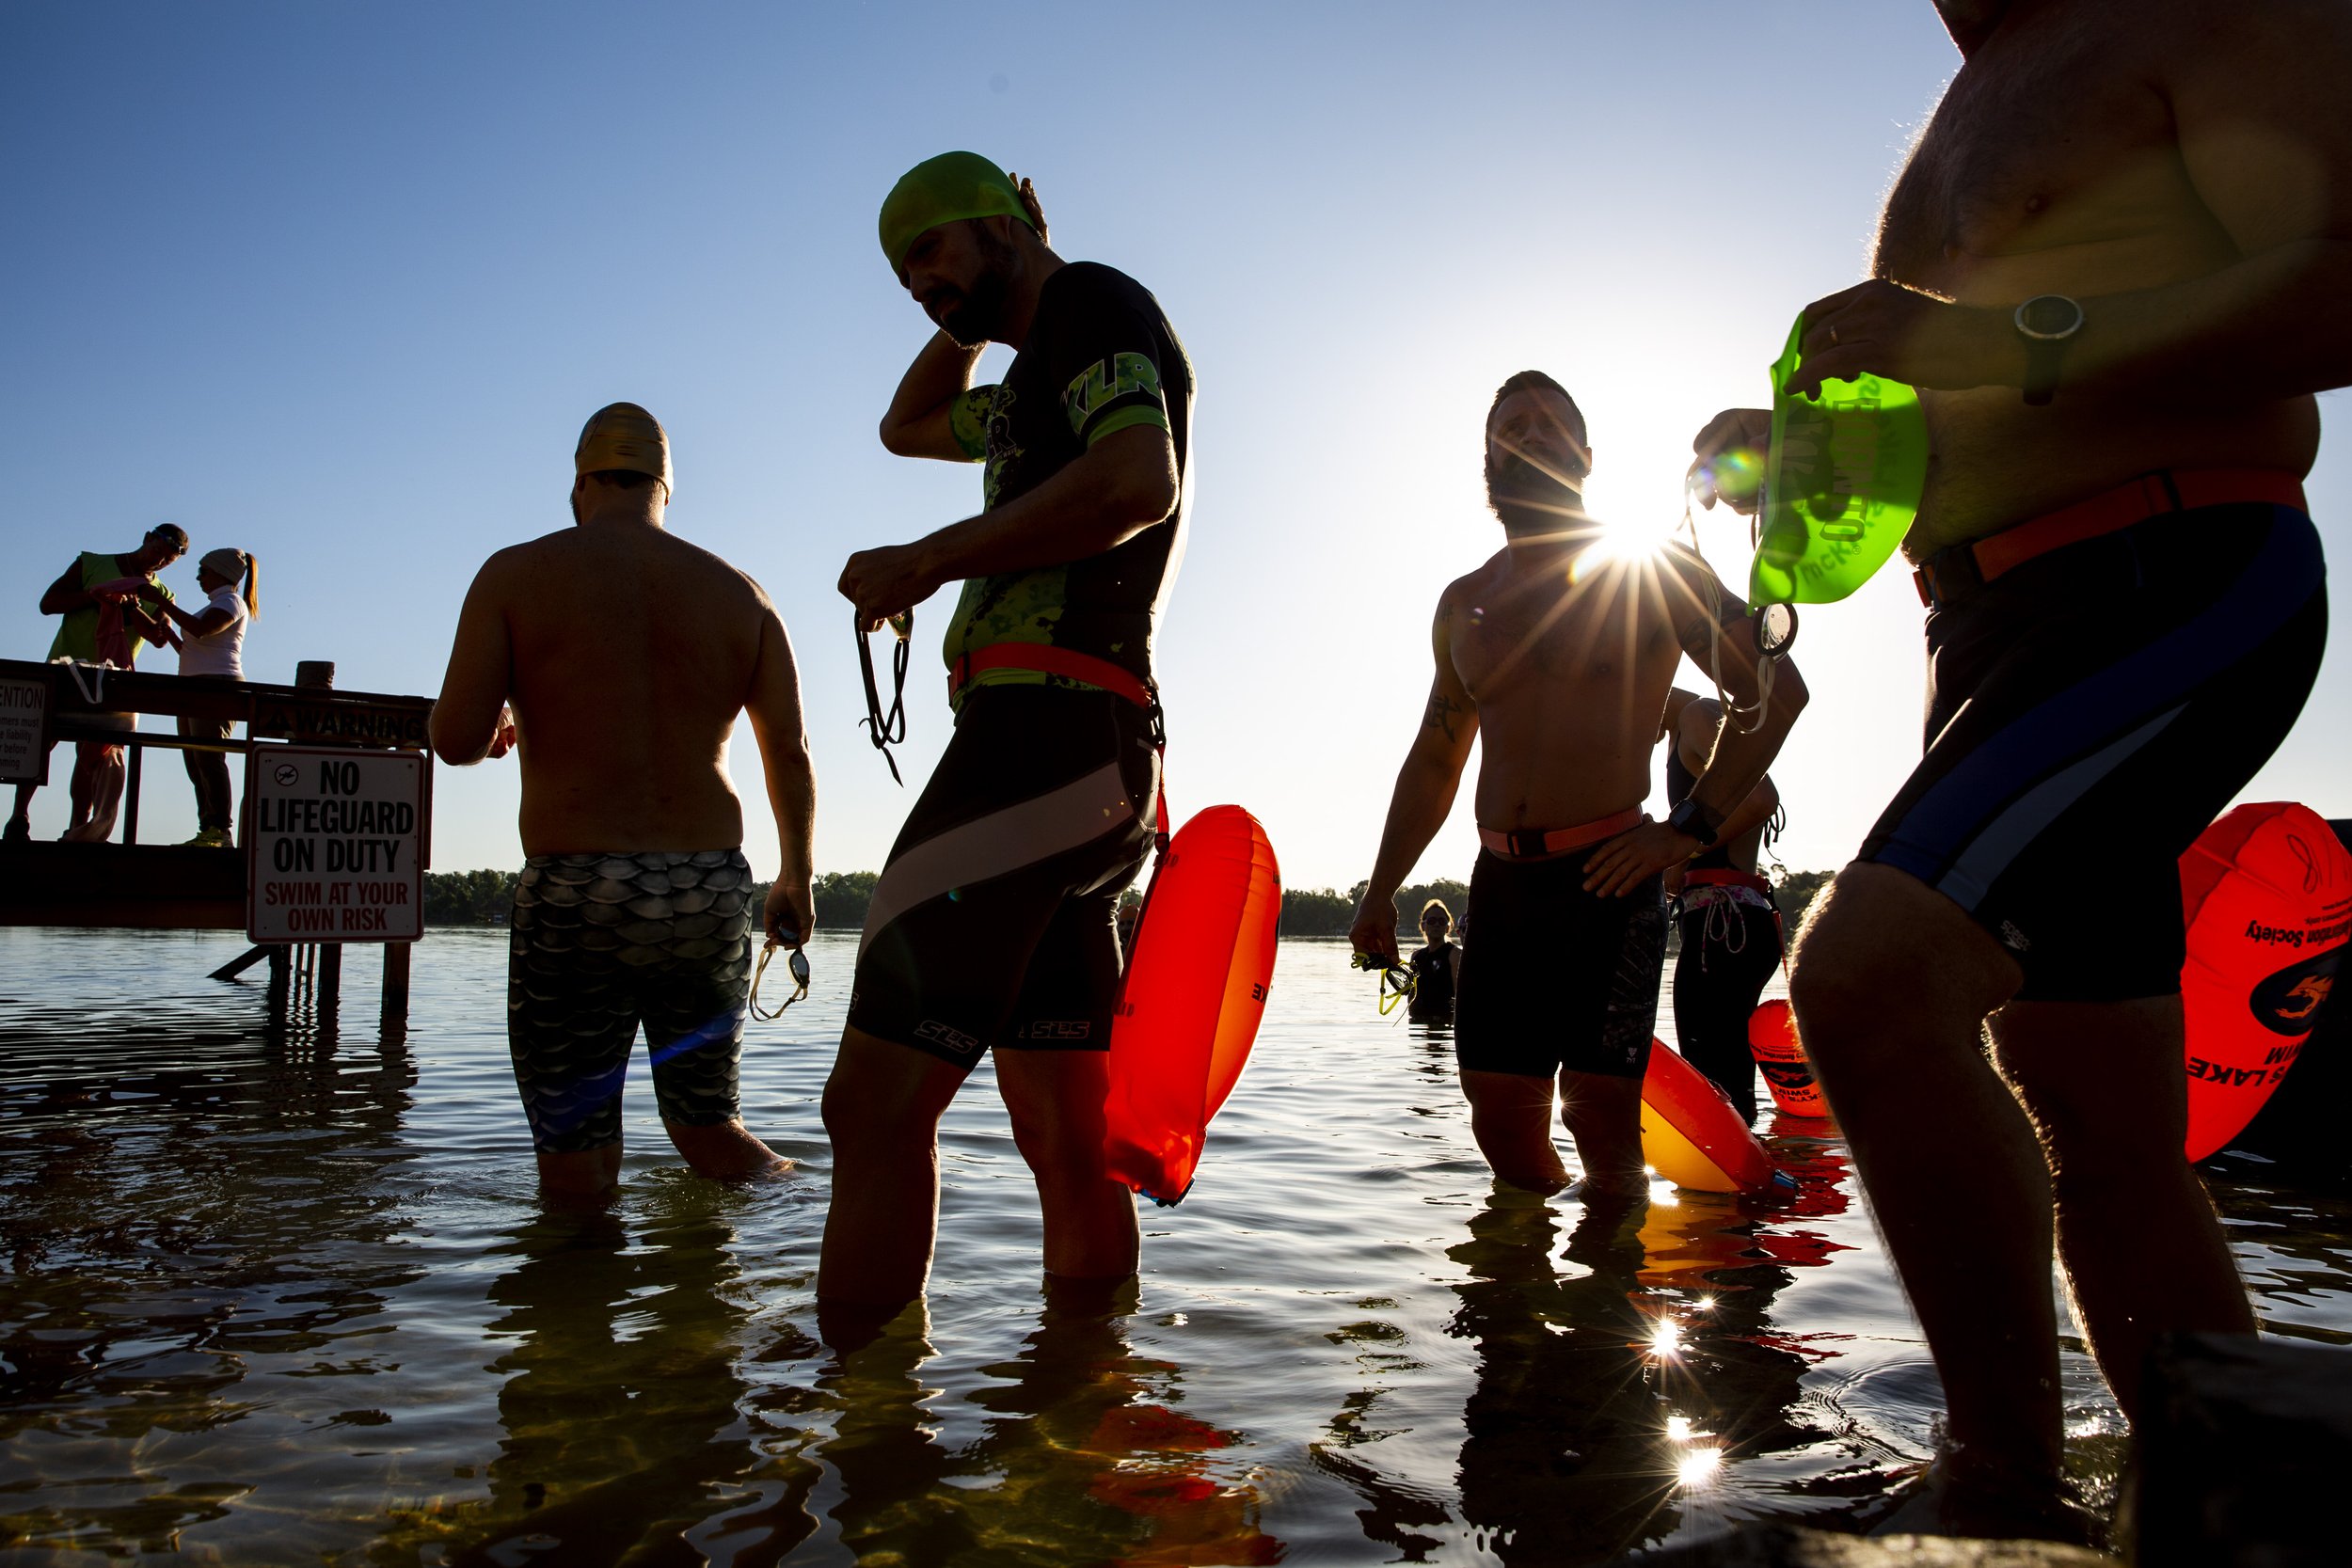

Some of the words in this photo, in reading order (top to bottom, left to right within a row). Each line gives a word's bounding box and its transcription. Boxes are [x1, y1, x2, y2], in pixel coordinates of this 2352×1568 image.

[21, 718, 40, 728] must
[296, 708, 423, 740] WARNING
[4, 743, 28, 755] before
[6, 729, 32, 744] liability
[320, 760, 360, 797] NO
[260, 798, 414, 835] LIFEGUARD
[273, 837, 314, 874] ON
[326, 838, 401, 874] DUTY
[264, 881, 322, 906] SWIM
[327, 881, 353, 905] AT
[357, 882, 408, 905] YOUR
[287, 908, 335, 932] OWN
[342, 908, 388, 931] RISK
[2244, 920, 2304, 948] Society
